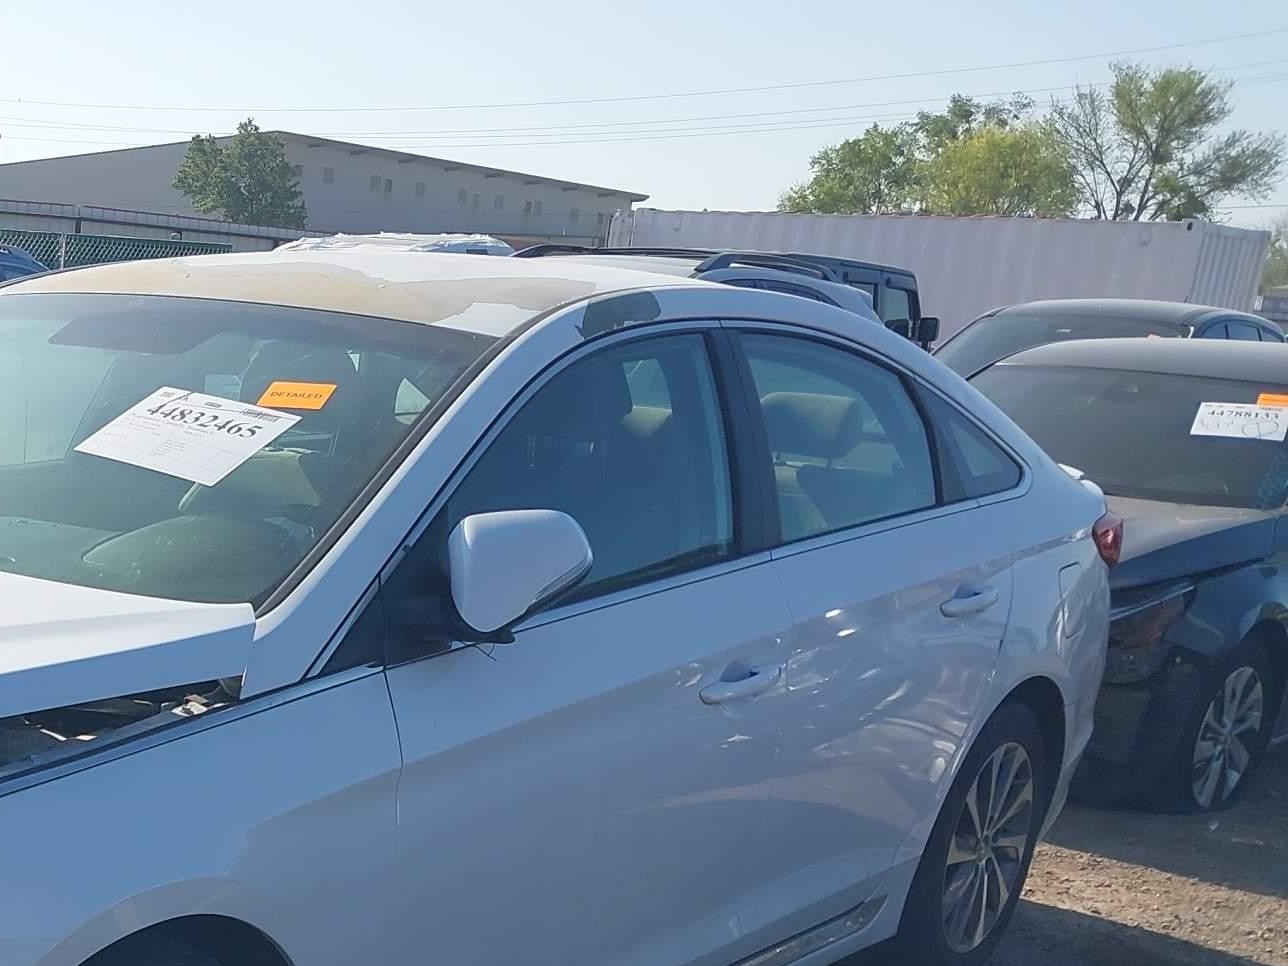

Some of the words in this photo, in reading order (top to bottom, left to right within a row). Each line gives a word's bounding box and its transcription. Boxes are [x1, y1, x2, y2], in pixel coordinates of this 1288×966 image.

[270, 390, 322, 400] DETAILED
[147, 401, 263, 438] 44832465
[1208, 410, 1280, 419] 44788133
